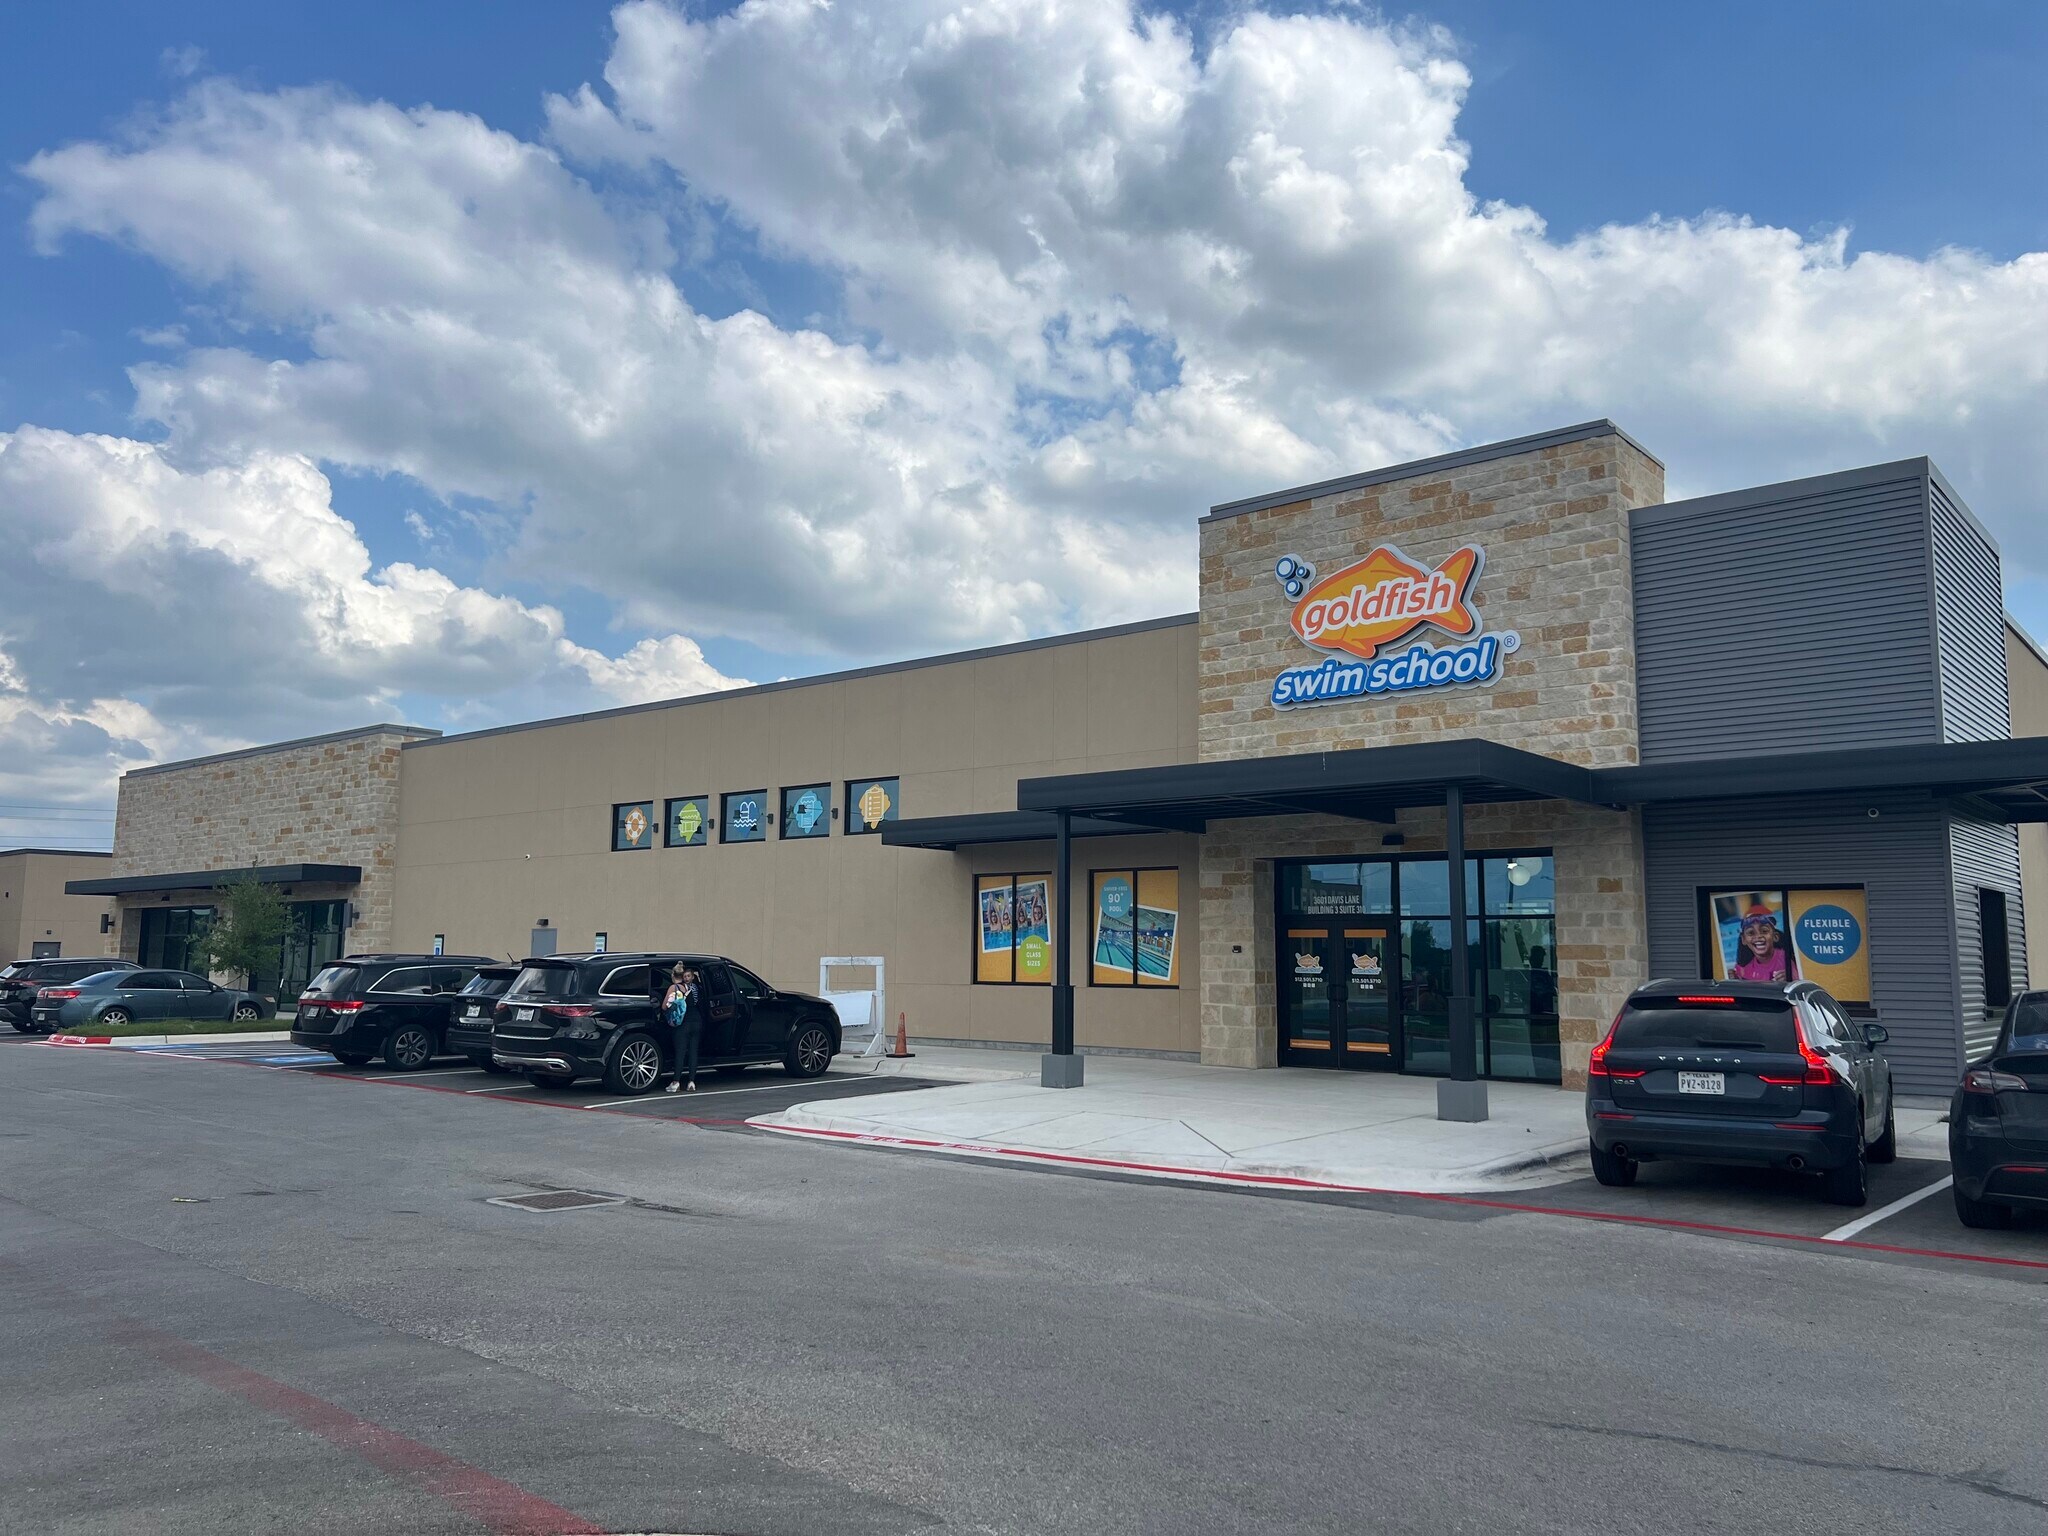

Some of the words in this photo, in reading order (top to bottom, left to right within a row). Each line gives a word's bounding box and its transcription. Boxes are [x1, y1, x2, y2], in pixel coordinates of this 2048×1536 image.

[1304, 576, 1451, 635] goldfish
[1275, 661, 1363, 700] swim
[1370, 641, 1491, 688] school
[1328, 895, 1344, 904] DAVIS
[1344, 895, 1360, 904] LANE
[1307, 905, 1334, 914] BUILDING
[1334, 905, 1339, 914] 3
[1339, 905, 1356, 914] SUITE
[1804, 919, 1850, 928] FLEXIBLE
[1811, 932, 1844, 941] CLASS
[1812, 945, 1845, 954] TIMES
